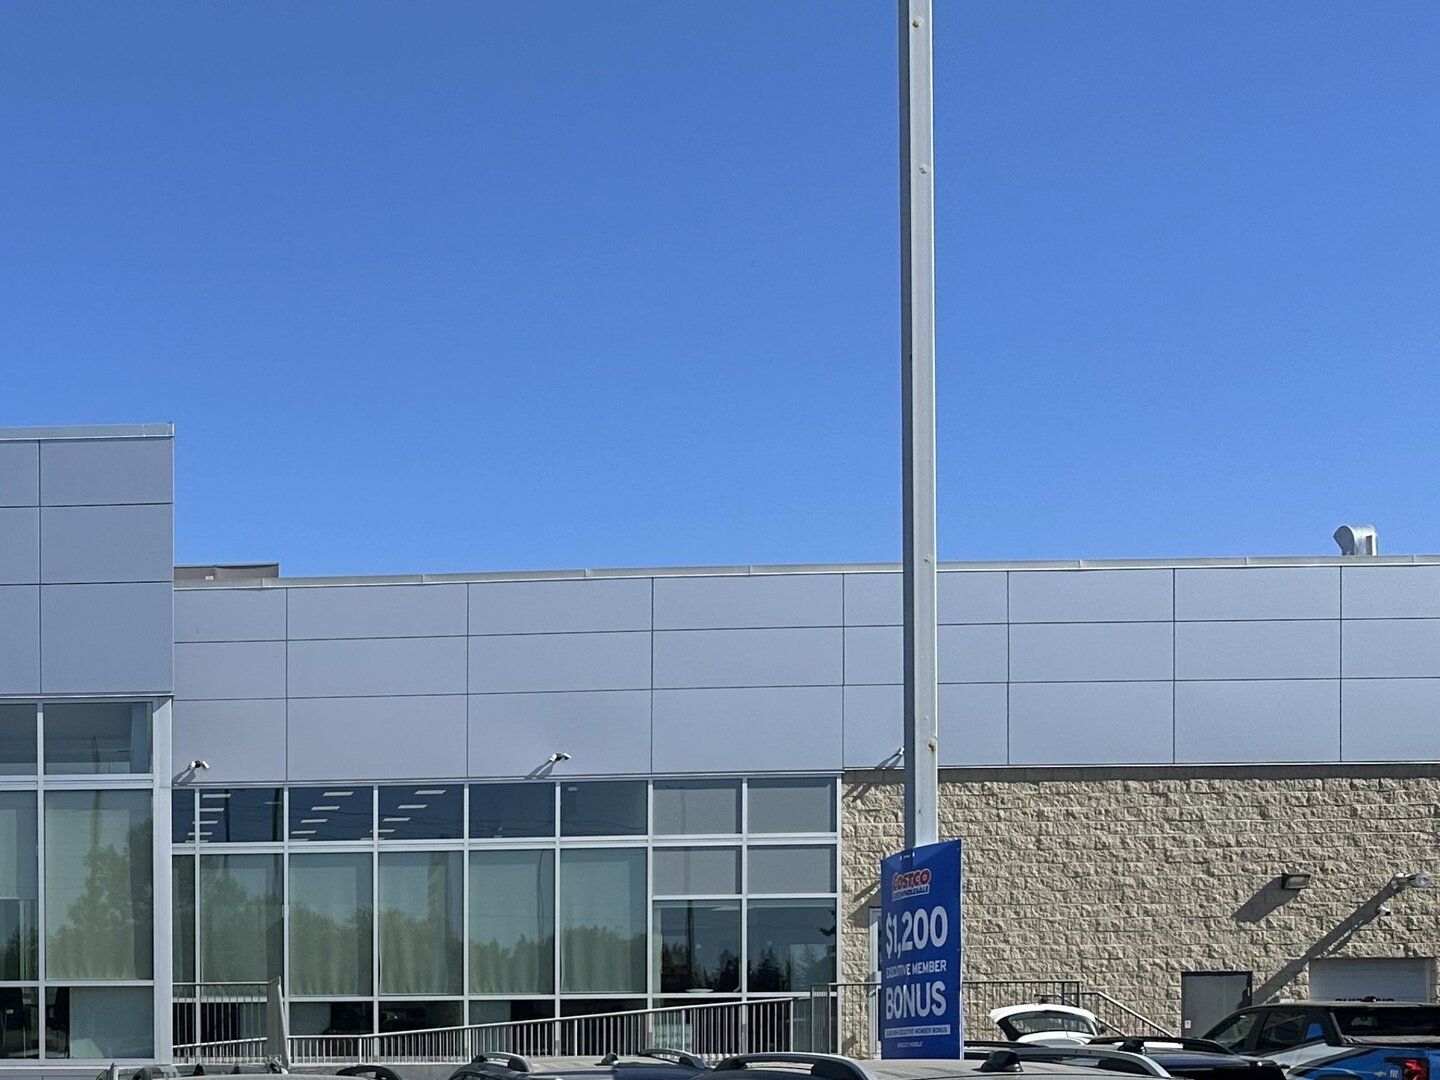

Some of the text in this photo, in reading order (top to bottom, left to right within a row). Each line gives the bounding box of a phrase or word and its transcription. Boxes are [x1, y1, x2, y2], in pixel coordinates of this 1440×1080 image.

[892, 868, 932, 892] COSTCO
[885, 905, 949, 959] $1,200
[912, 959, 947, 975] MEMBER
[885, 980, 947, 1020] BONUS
